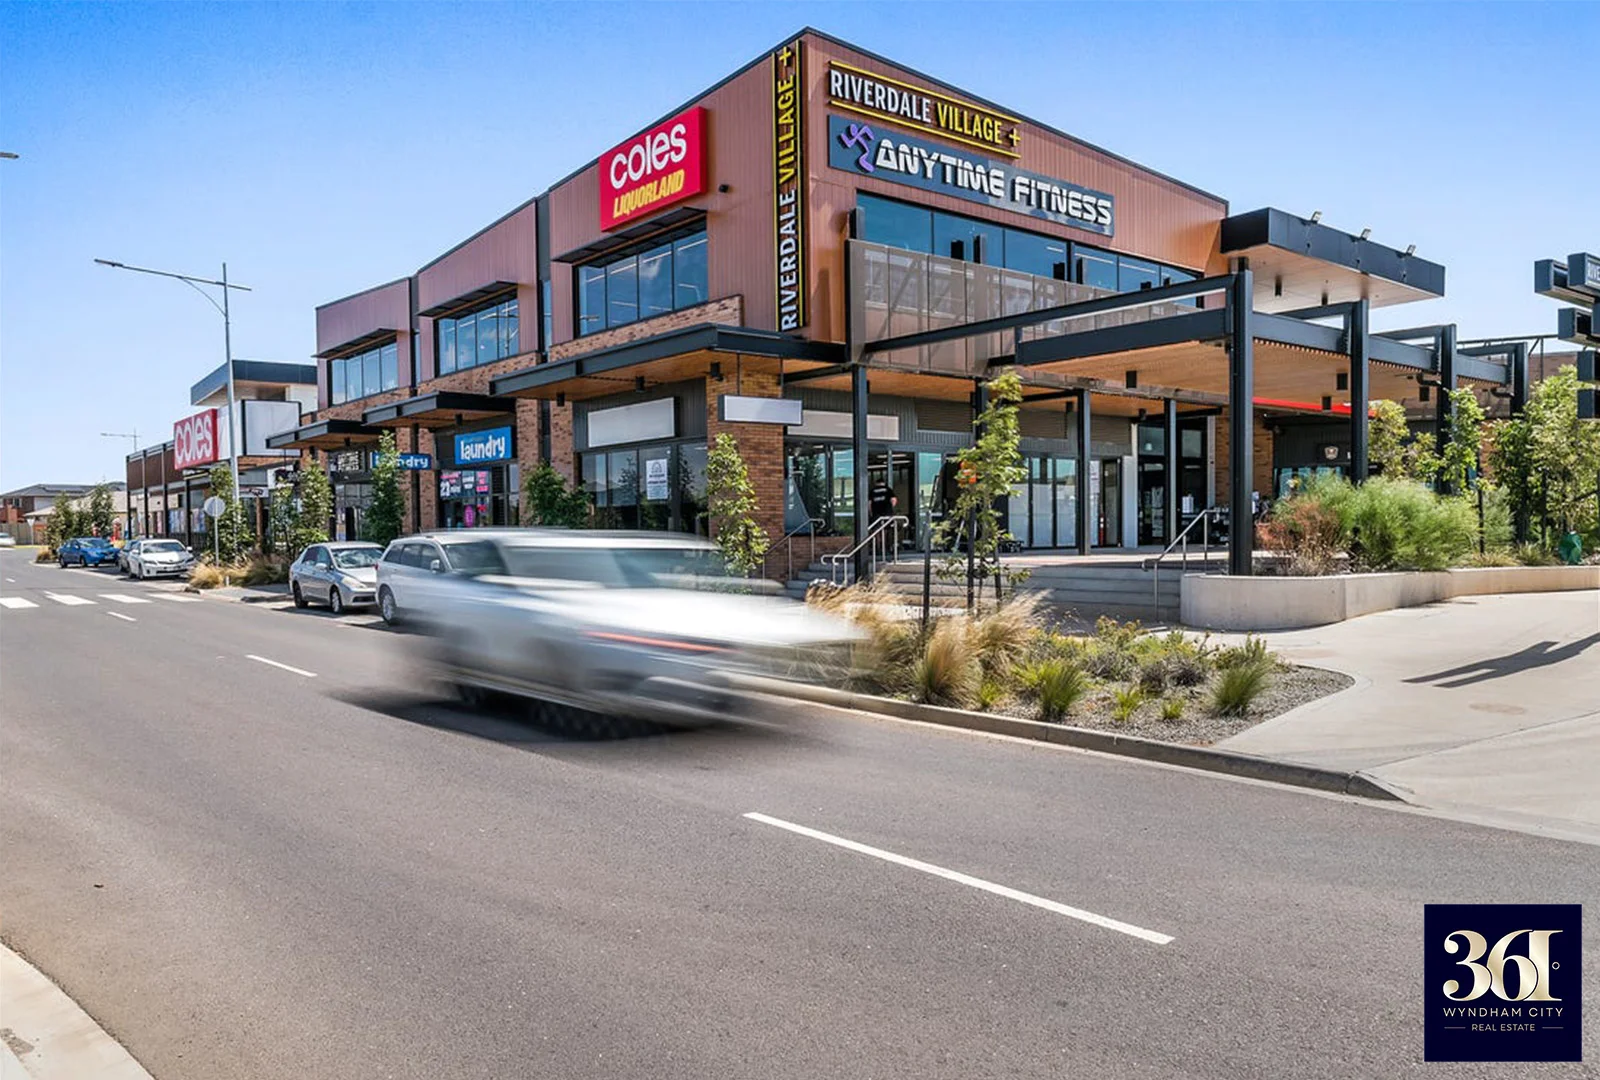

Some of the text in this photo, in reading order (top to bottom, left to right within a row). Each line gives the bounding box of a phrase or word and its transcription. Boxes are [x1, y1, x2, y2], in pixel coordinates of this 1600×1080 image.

[778, 75, 795, 184] VILLAGE
[830, 69, 932, 123] RIVERDALE
[937, 102, 1003, 144] VILLAGE
[610, 123, 687, 189] coles
[875, 138, 1113, 226] ANYTIME FITNESS
[613, 169, 685, 219] LIQUORLAND
[780, 189, 798, 331] RIVERDALE
[174, 414, 213, 465] coles
[460, 434, 505, 461] laundry
